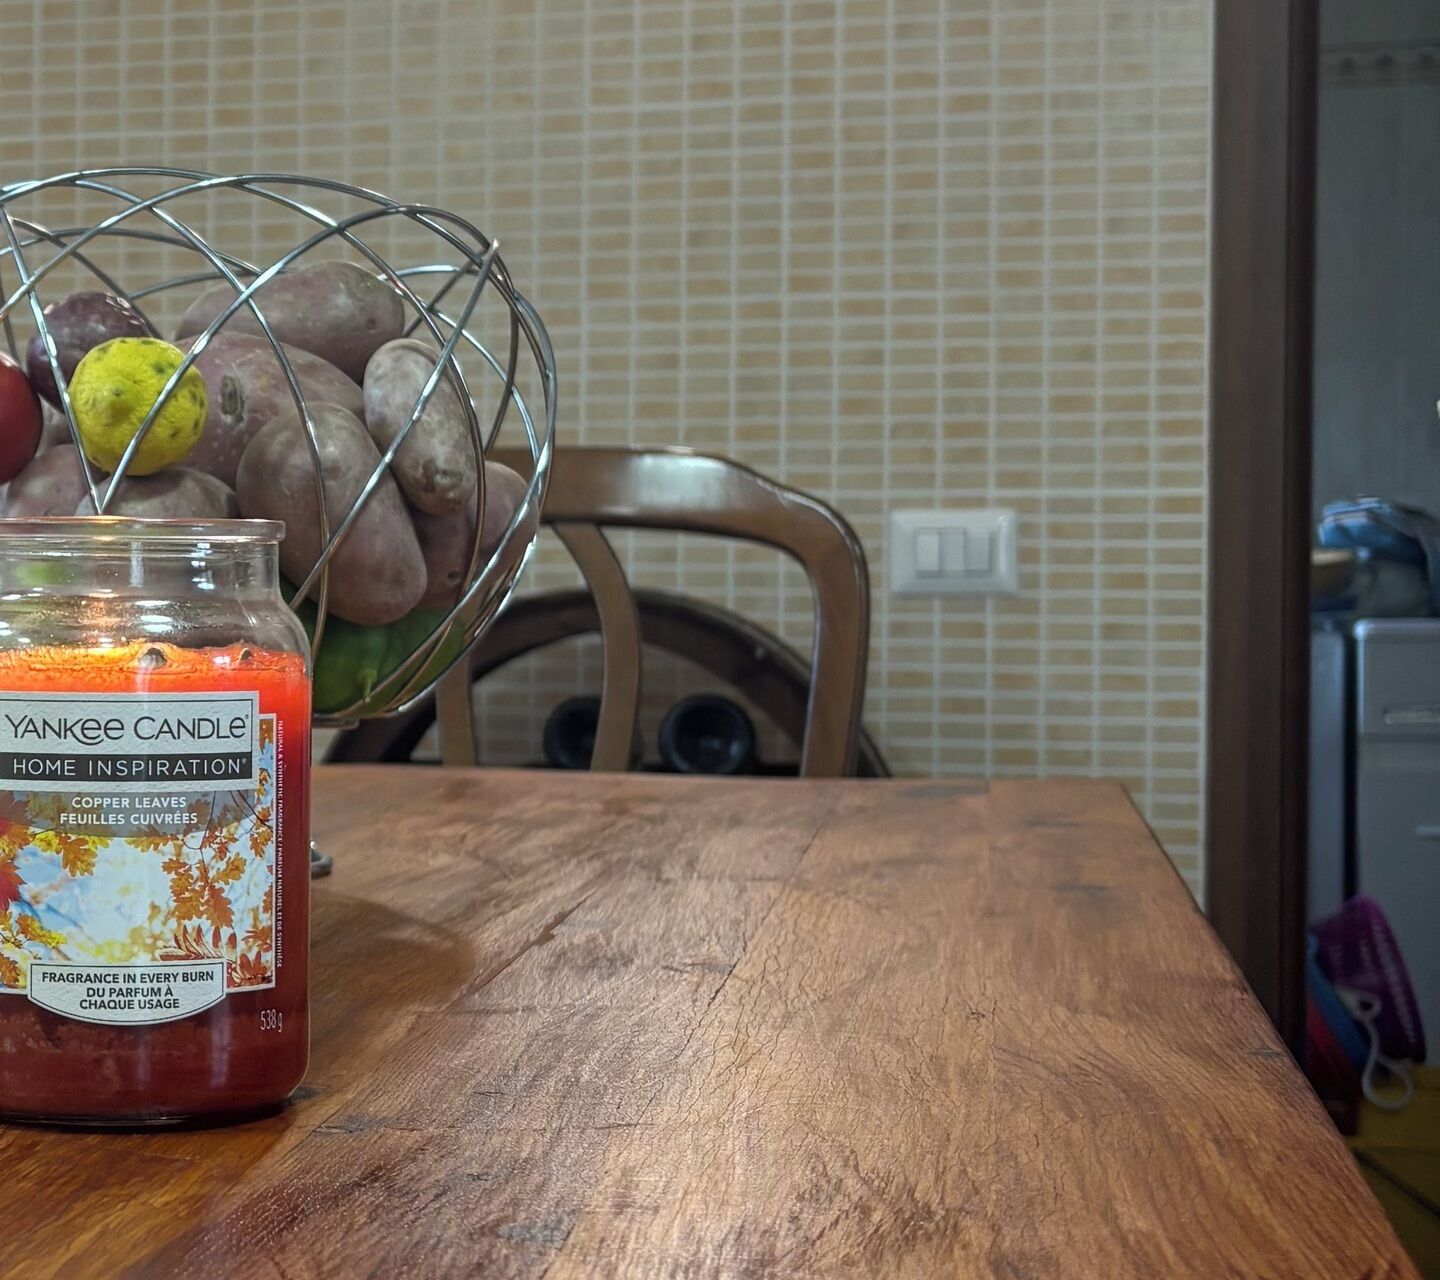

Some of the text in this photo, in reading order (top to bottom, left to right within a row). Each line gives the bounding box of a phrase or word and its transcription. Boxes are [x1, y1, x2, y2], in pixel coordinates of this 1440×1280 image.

[13, 757, 241, 776] HOME INSPIRATION
[71, 797, 187, 808] COPPER LEAVES
[60, 810, 198, 825] FEUILLES CUIVRÉES
[42, 971, 214, 984] FRAGRANCE IN EVERY BURN
[87, 984, 173, 997] DU PARFUM À
[79, 998, 180, 1010] CHAQUE USAGE
